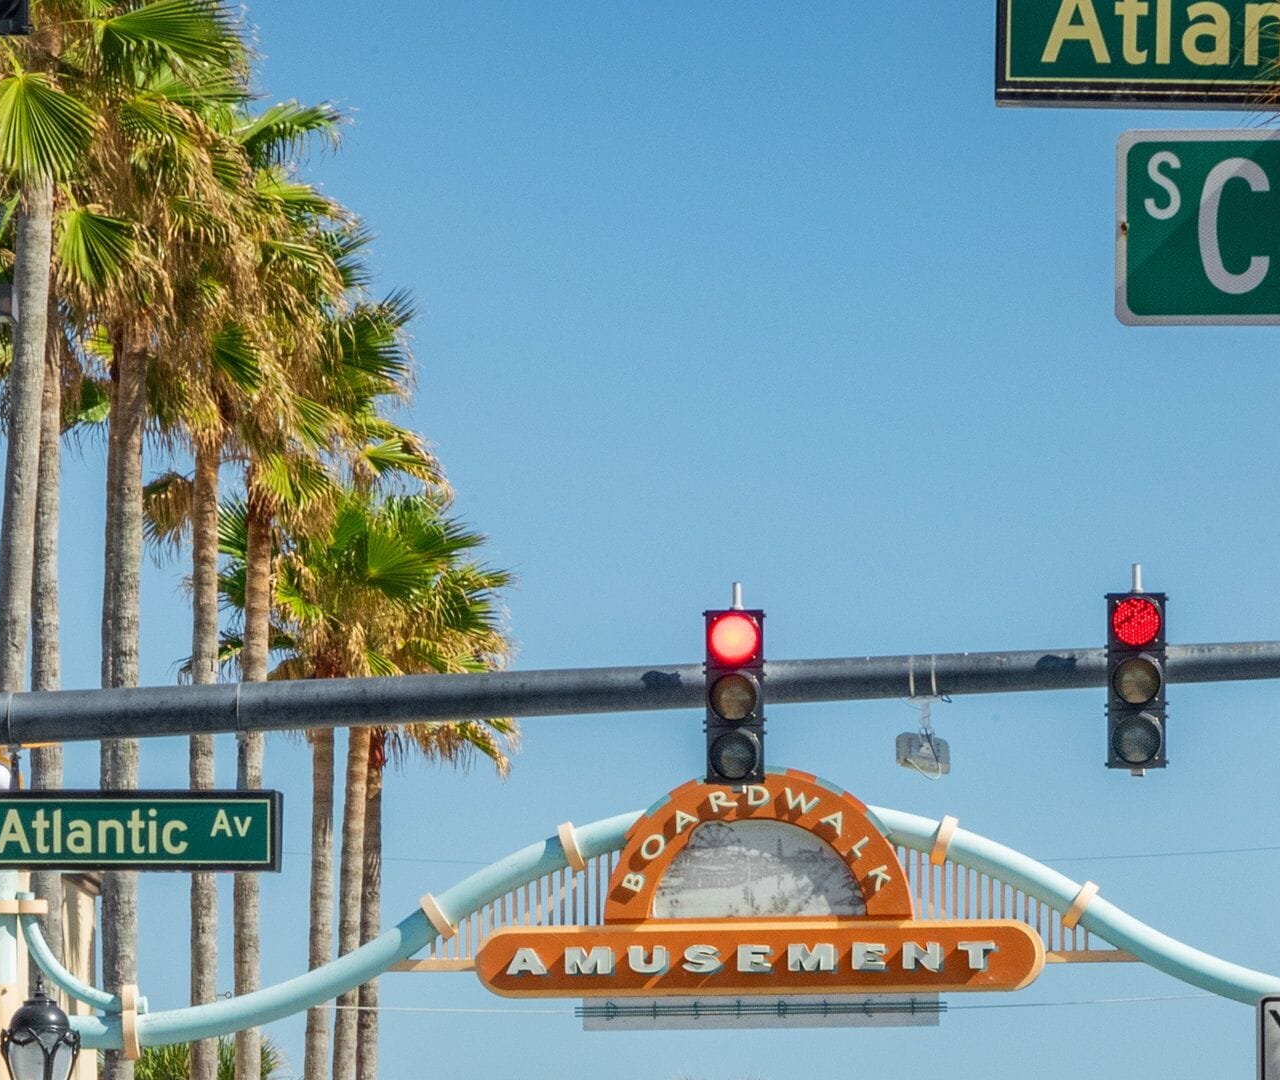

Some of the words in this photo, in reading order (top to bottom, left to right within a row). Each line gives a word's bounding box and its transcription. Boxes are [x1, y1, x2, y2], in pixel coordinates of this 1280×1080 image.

[1144, 150, 1182, 220] S
[210, 809, 252, 838] Av
[621, 784, 892, 893] BOARDWALK
[505, 942, 998, 975] AMUSEMENT
